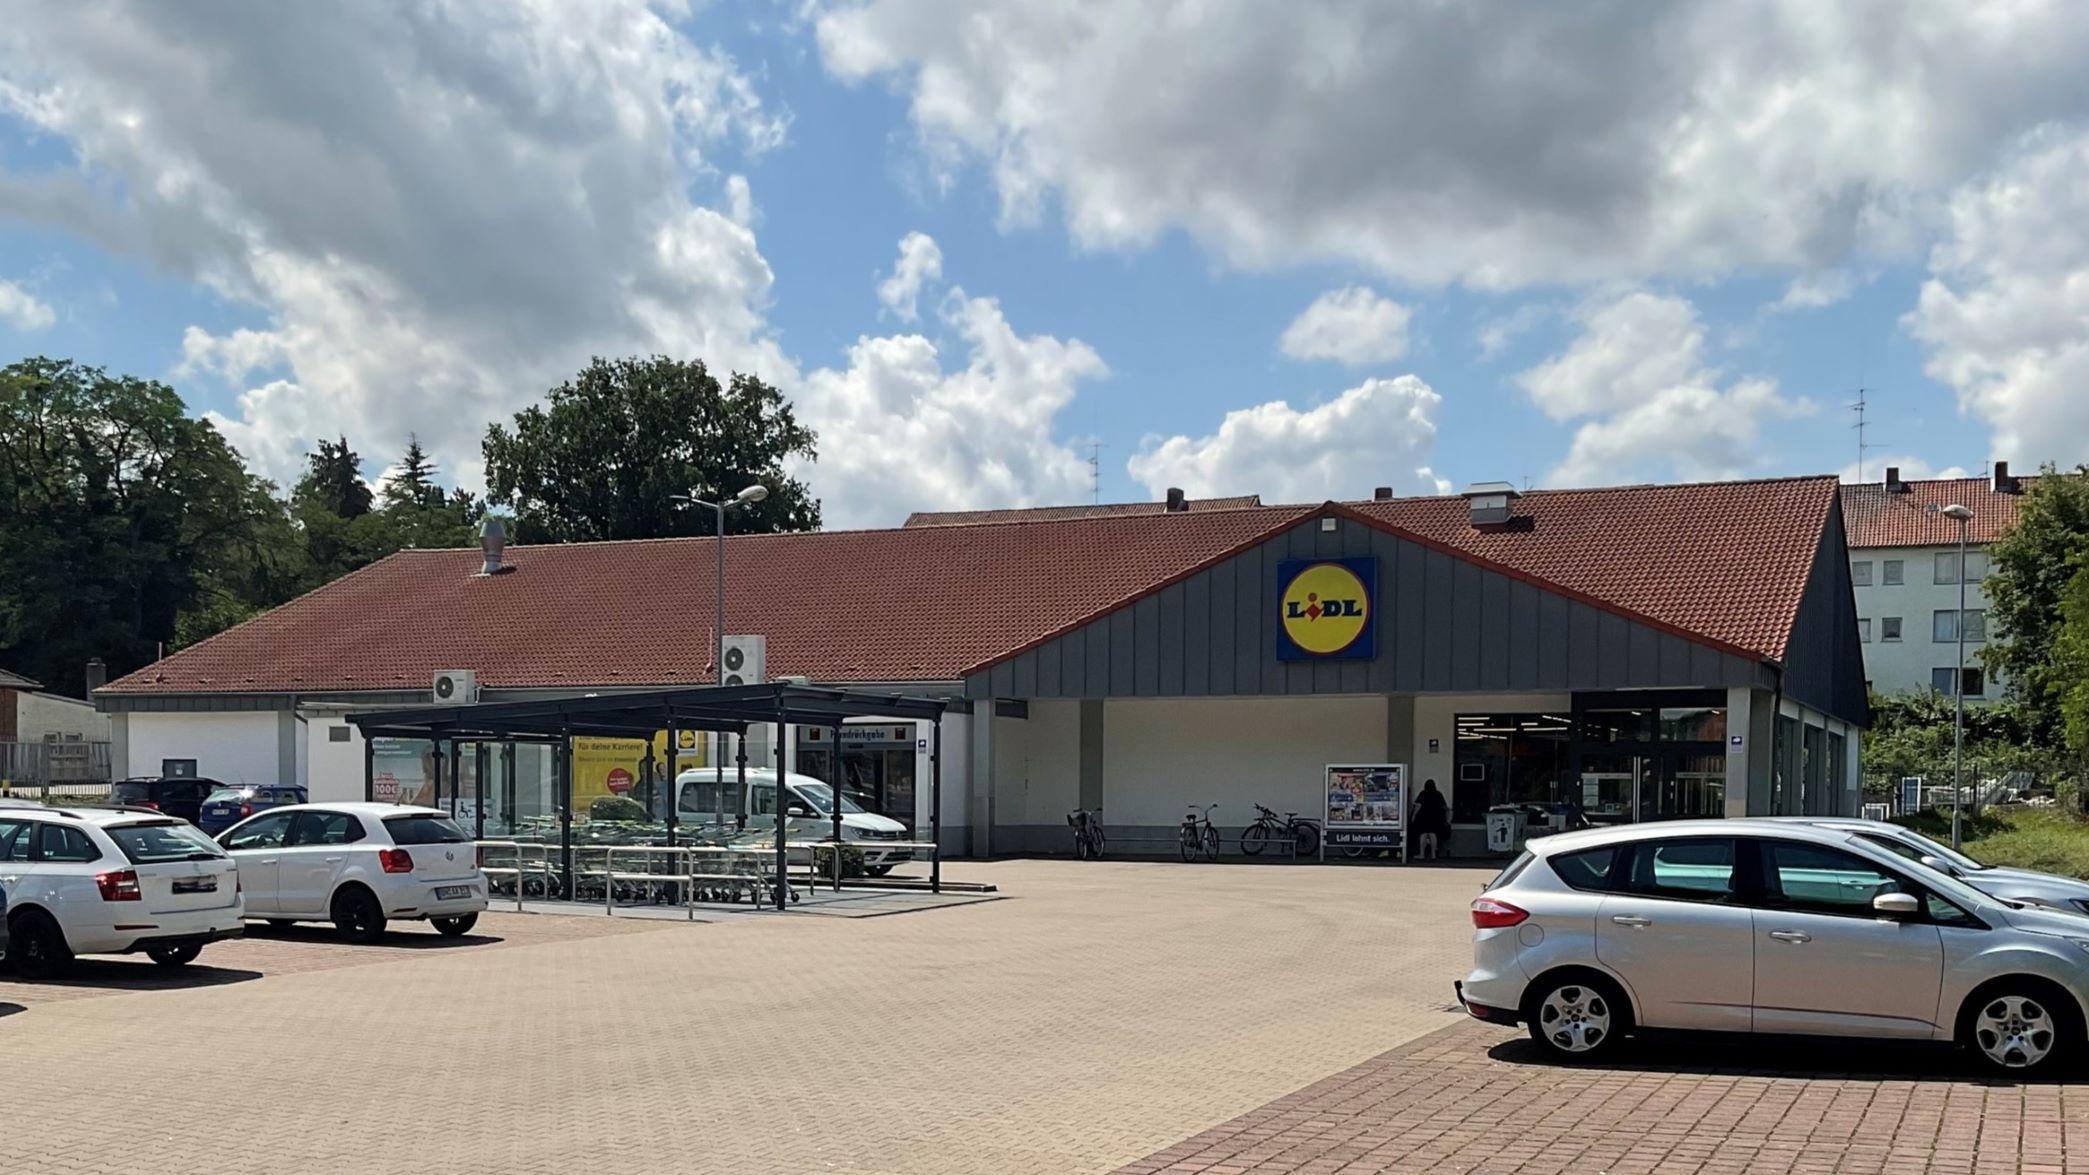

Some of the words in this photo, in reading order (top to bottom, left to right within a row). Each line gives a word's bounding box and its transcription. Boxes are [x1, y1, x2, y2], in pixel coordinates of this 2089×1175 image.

[591, 742, 611, 751] deine
[1336, 833, 1350, 842] Lidl
[1352, 834, 1371, 842] lohnt
